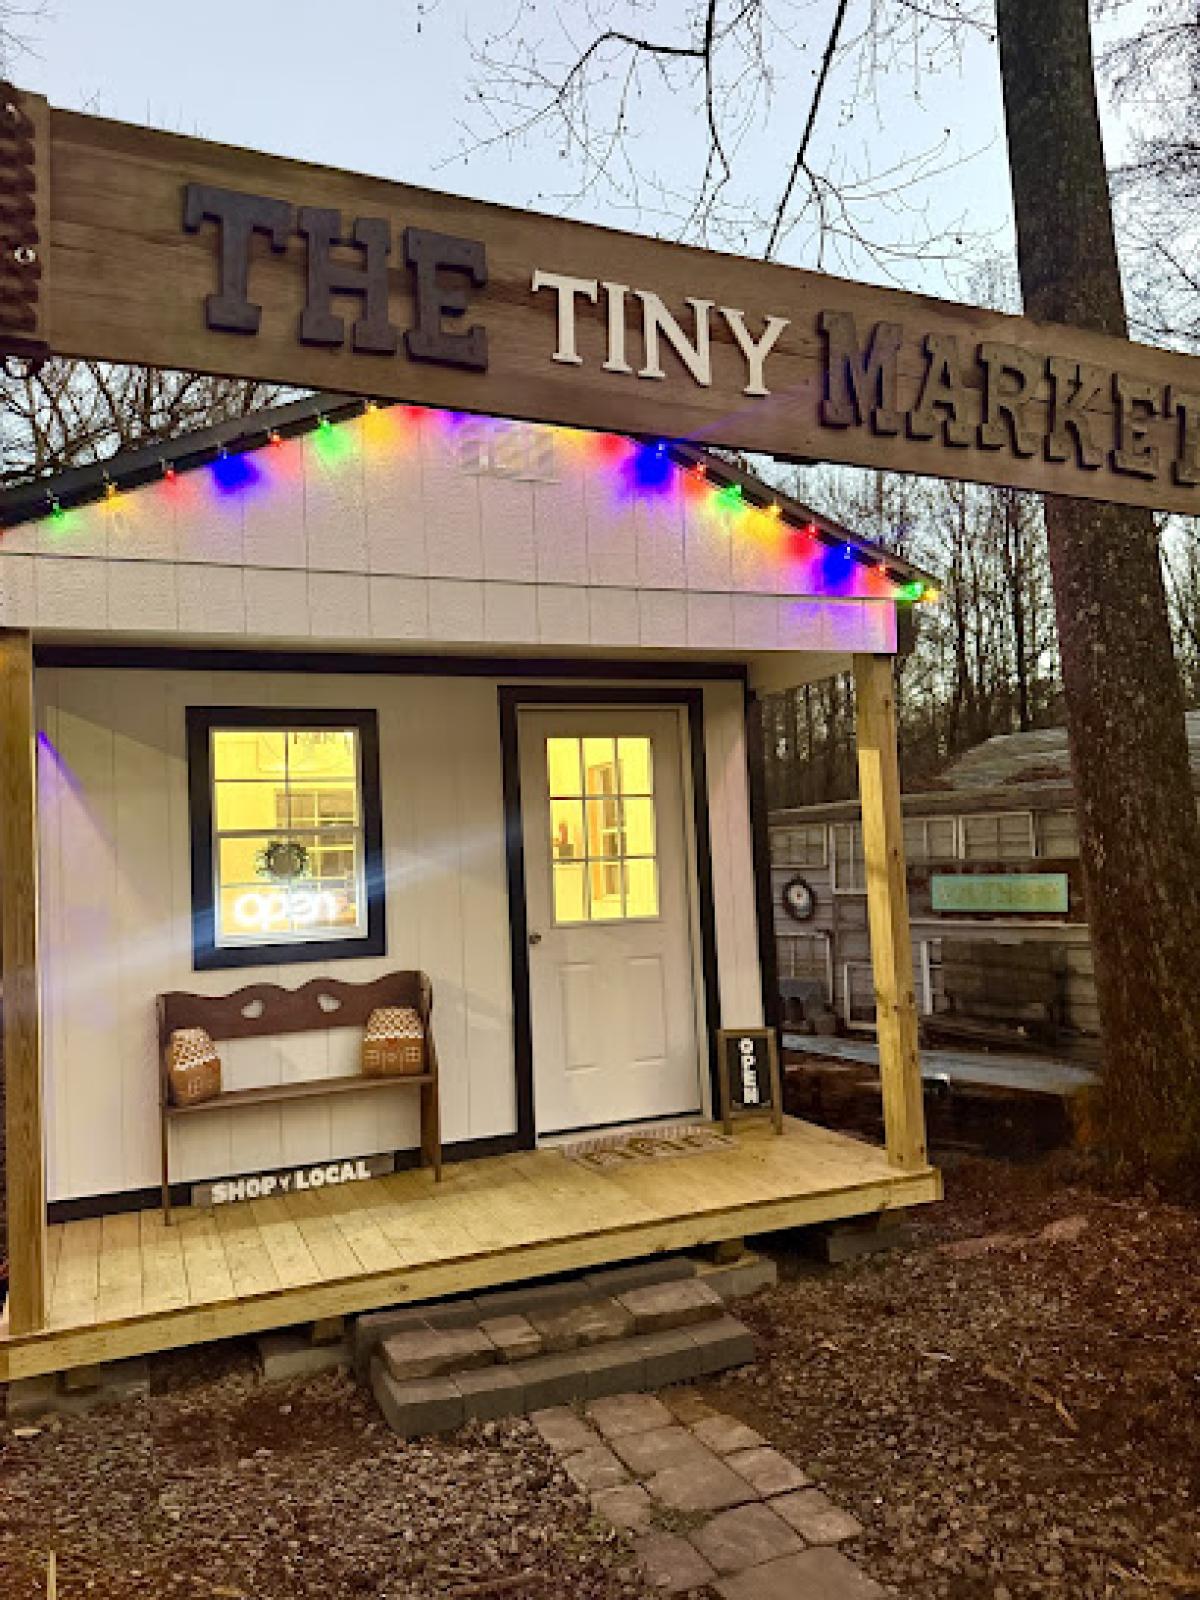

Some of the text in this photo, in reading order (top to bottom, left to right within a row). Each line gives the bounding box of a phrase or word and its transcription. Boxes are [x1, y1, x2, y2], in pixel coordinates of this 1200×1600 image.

[183, 182, 488, 371] THE
[531, 269, 791, 396] TINY
[738, 1037, 760, 1104] OPEN
[211, 1161, 372, 1204] SHOP LOCAL
